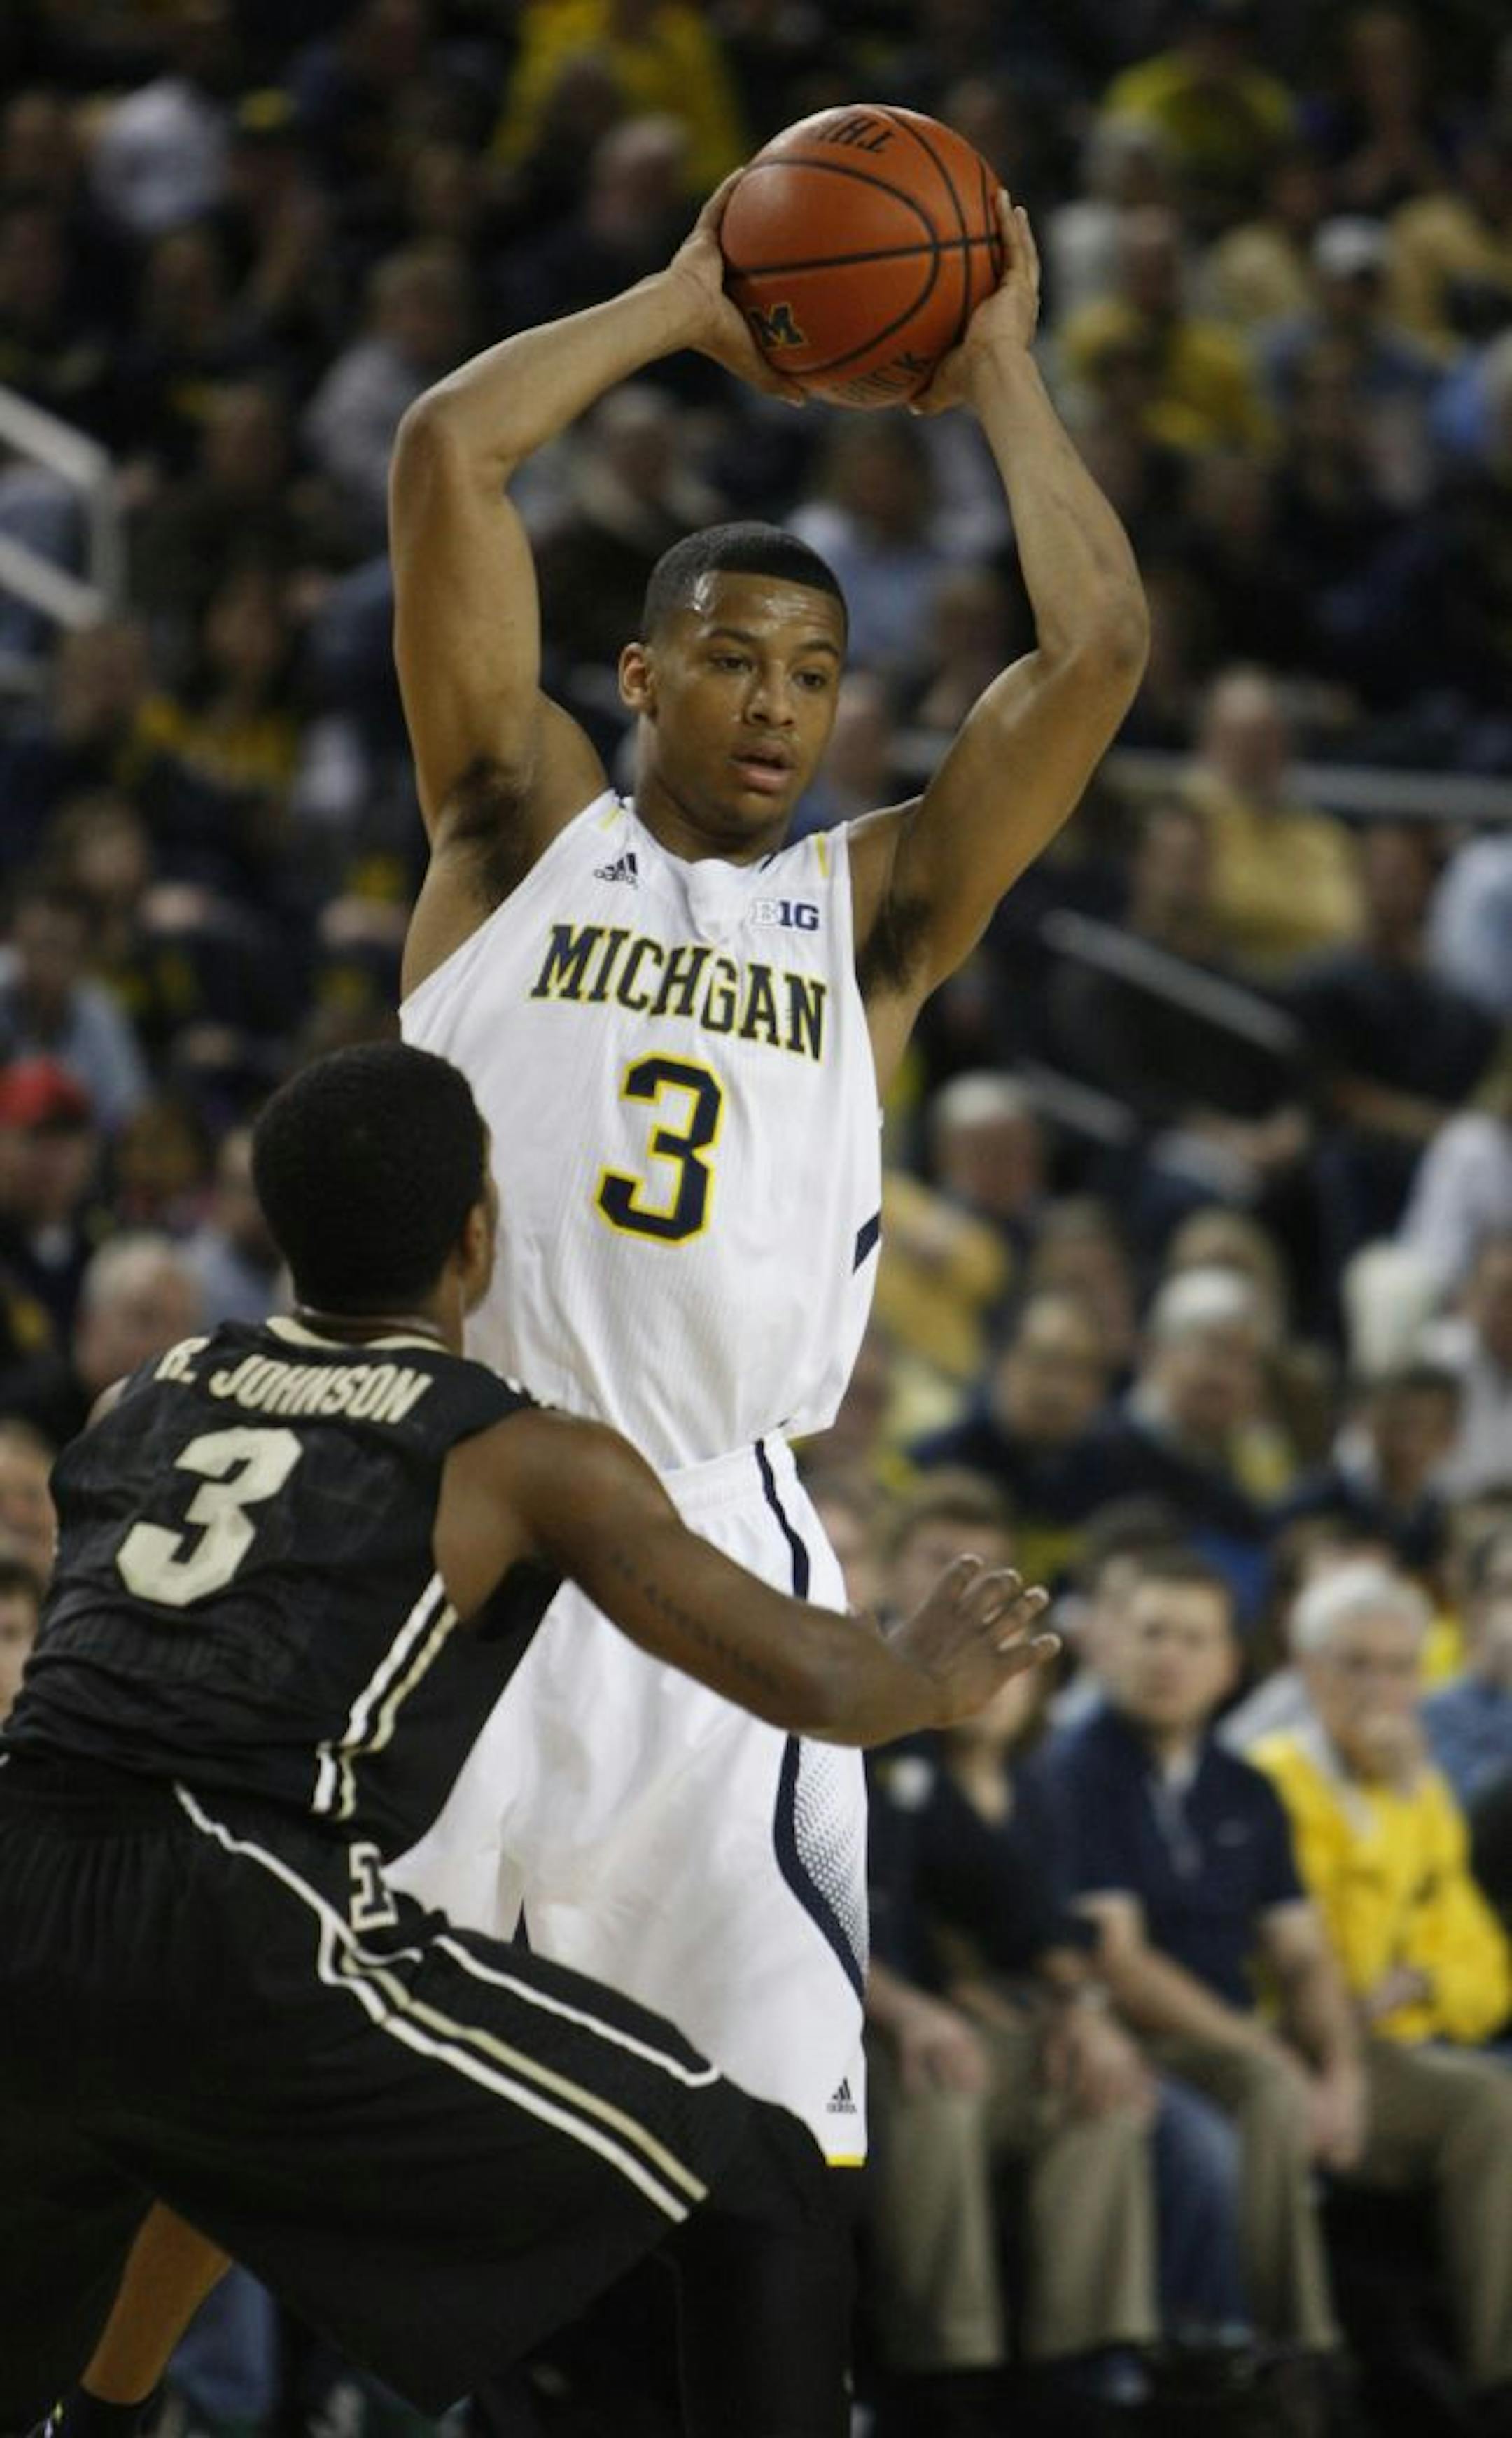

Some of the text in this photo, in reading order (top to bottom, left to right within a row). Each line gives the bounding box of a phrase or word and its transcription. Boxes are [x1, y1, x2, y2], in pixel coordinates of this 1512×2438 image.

[747, 303, 806, 349] M
[528, 923, 827, 1063] MICHGAN
[594, 1051, 726, 1247] 3
[209, 1354, 433, 1423] JOHNSON
[116, 1427, 304, 1606] 3
